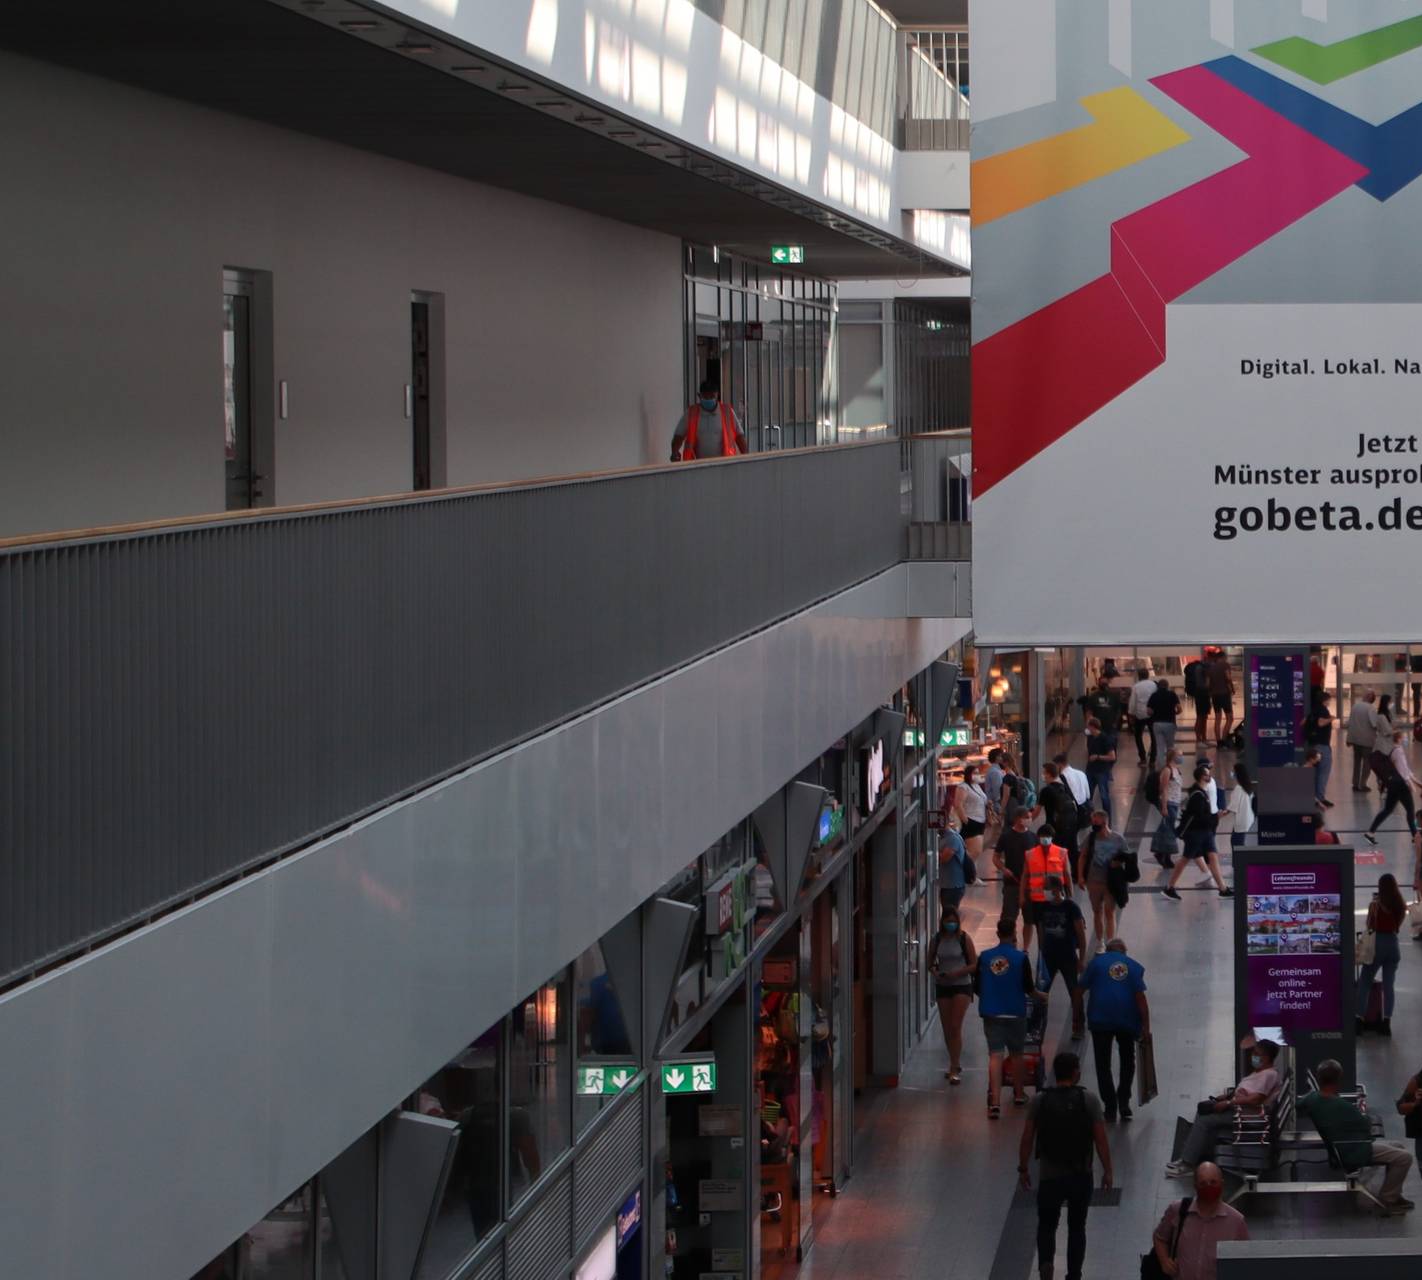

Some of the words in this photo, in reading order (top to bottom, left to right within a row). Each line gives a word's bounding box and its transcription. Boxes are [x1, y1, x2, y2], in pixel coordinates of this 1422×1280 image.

[1240, 358, 1315, 379] Digital.
[1324, 358, 1386, 375] Lokal.
[1356, 433, 1418, 458] Jetzt
[1214, 464, 1322, 485] Münster
[1268, 967, 1322, 976] Gemeinsam
[1277, 978, 1307, 988] online
[1266, 989, 1287, 1000] jetzt
[1289, 989, 1323, 999] Partner
[1279, 1001, 1311, 1010] finden!
